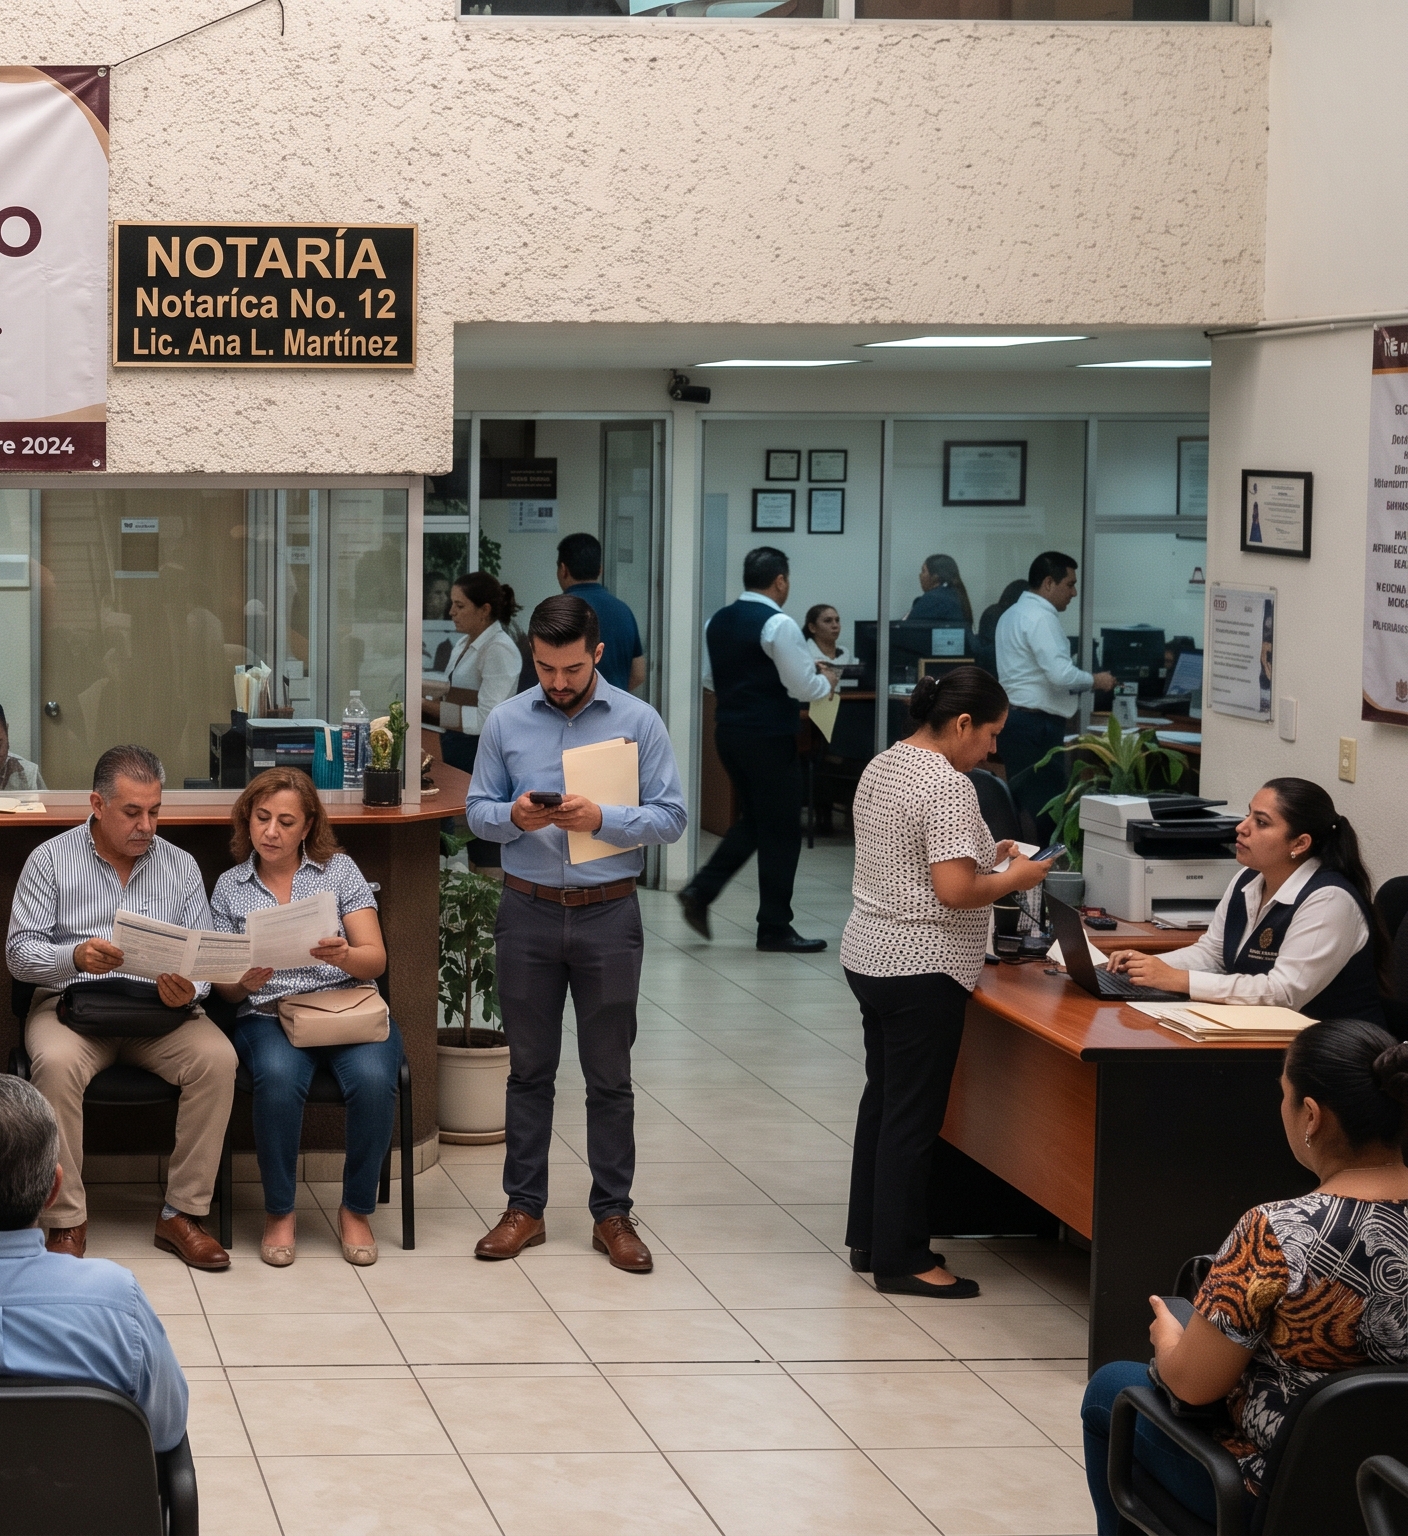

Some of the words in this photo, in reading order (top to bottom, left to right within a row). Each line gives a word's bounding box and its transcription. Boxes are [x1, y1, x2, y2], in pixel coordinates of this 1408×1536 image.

[147, 228, 387, 279] NOTARÍA
[137, 288, 278, 318] Notaríca
[291, 289, 344, 318] No.
[359, 289, 395, 318] 12
[134, 328, 179, 355] Lic.
[188, 328, 240, 355] Ana
[252, 329, 273, 355] L.
[285, 329, 397, 356] Martínez
[22, 437, 74, 454] 2024
